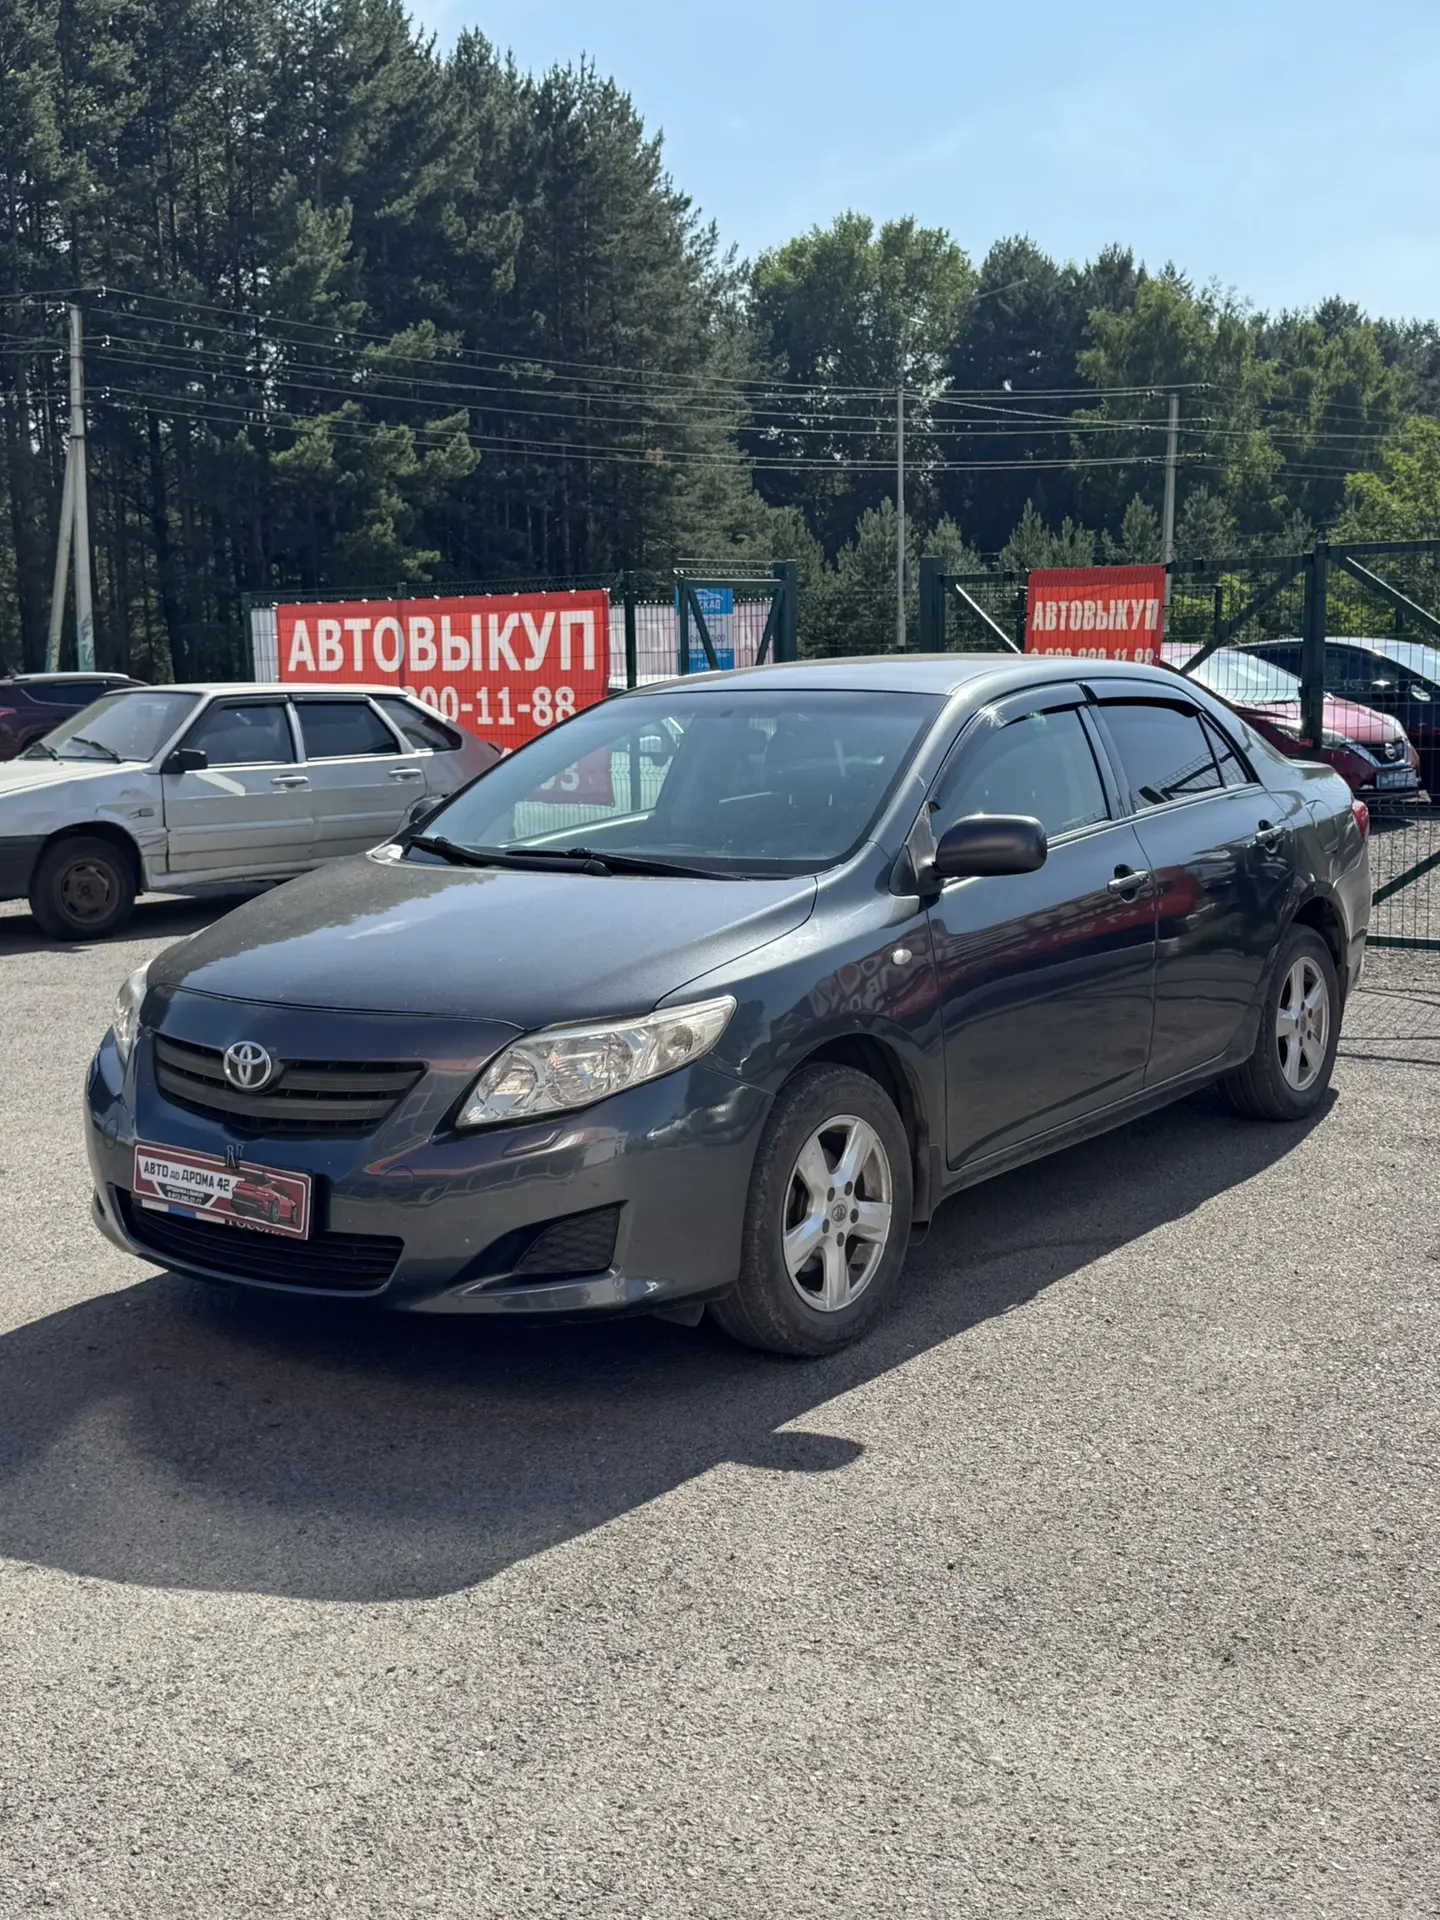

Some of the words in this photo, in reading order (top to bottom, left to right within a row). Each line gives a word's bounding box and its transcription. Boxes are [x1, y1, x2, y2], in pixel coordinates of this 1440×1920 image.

[1031, 600, 1159, 631] АВТОВЫКУП
[287, 610, 595, 672] АВТОВЫКУП
[144, 1161, 169, 1177] АВТО
[181, 1169, 215, 1189] ДРОМА
[216, 1177, 231, 1192] 42
